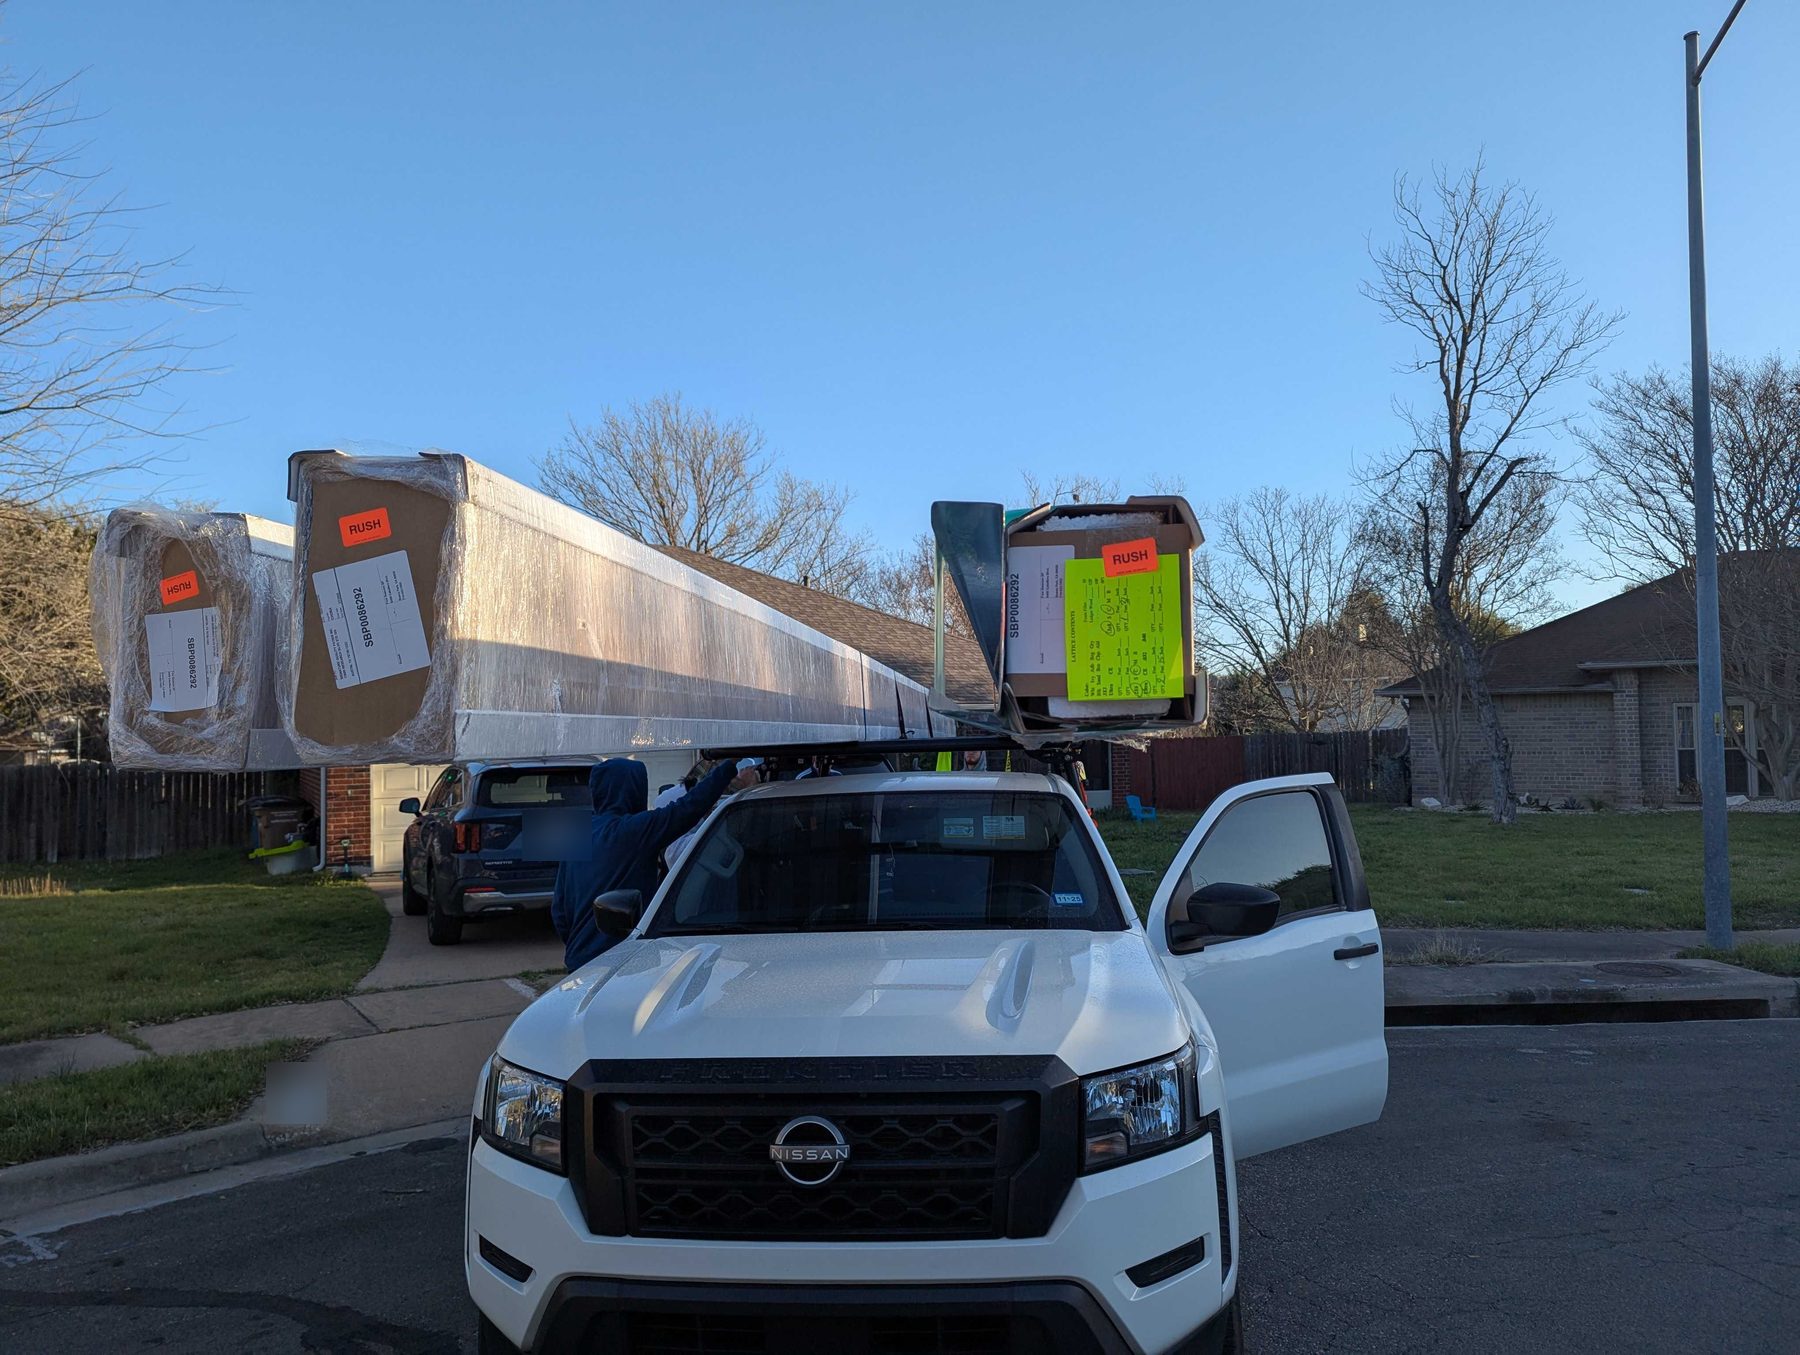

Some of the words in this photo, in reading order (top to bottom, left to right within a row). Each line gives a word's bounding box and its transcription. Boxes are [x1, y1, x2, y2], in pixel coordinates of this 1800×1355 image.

[349, 519, 381, 535] RUSH
[1112, 550, 1149, 565] RUSH
[167, 581, 191, 596] RUSH
[1010, 573, 1019, 638] SBP0086292
[352, 586, 374, 648] SBP0086292
[187, 637, 197, 689] SBP0086292
[771, 1146, 850, 1160] NISSAN
